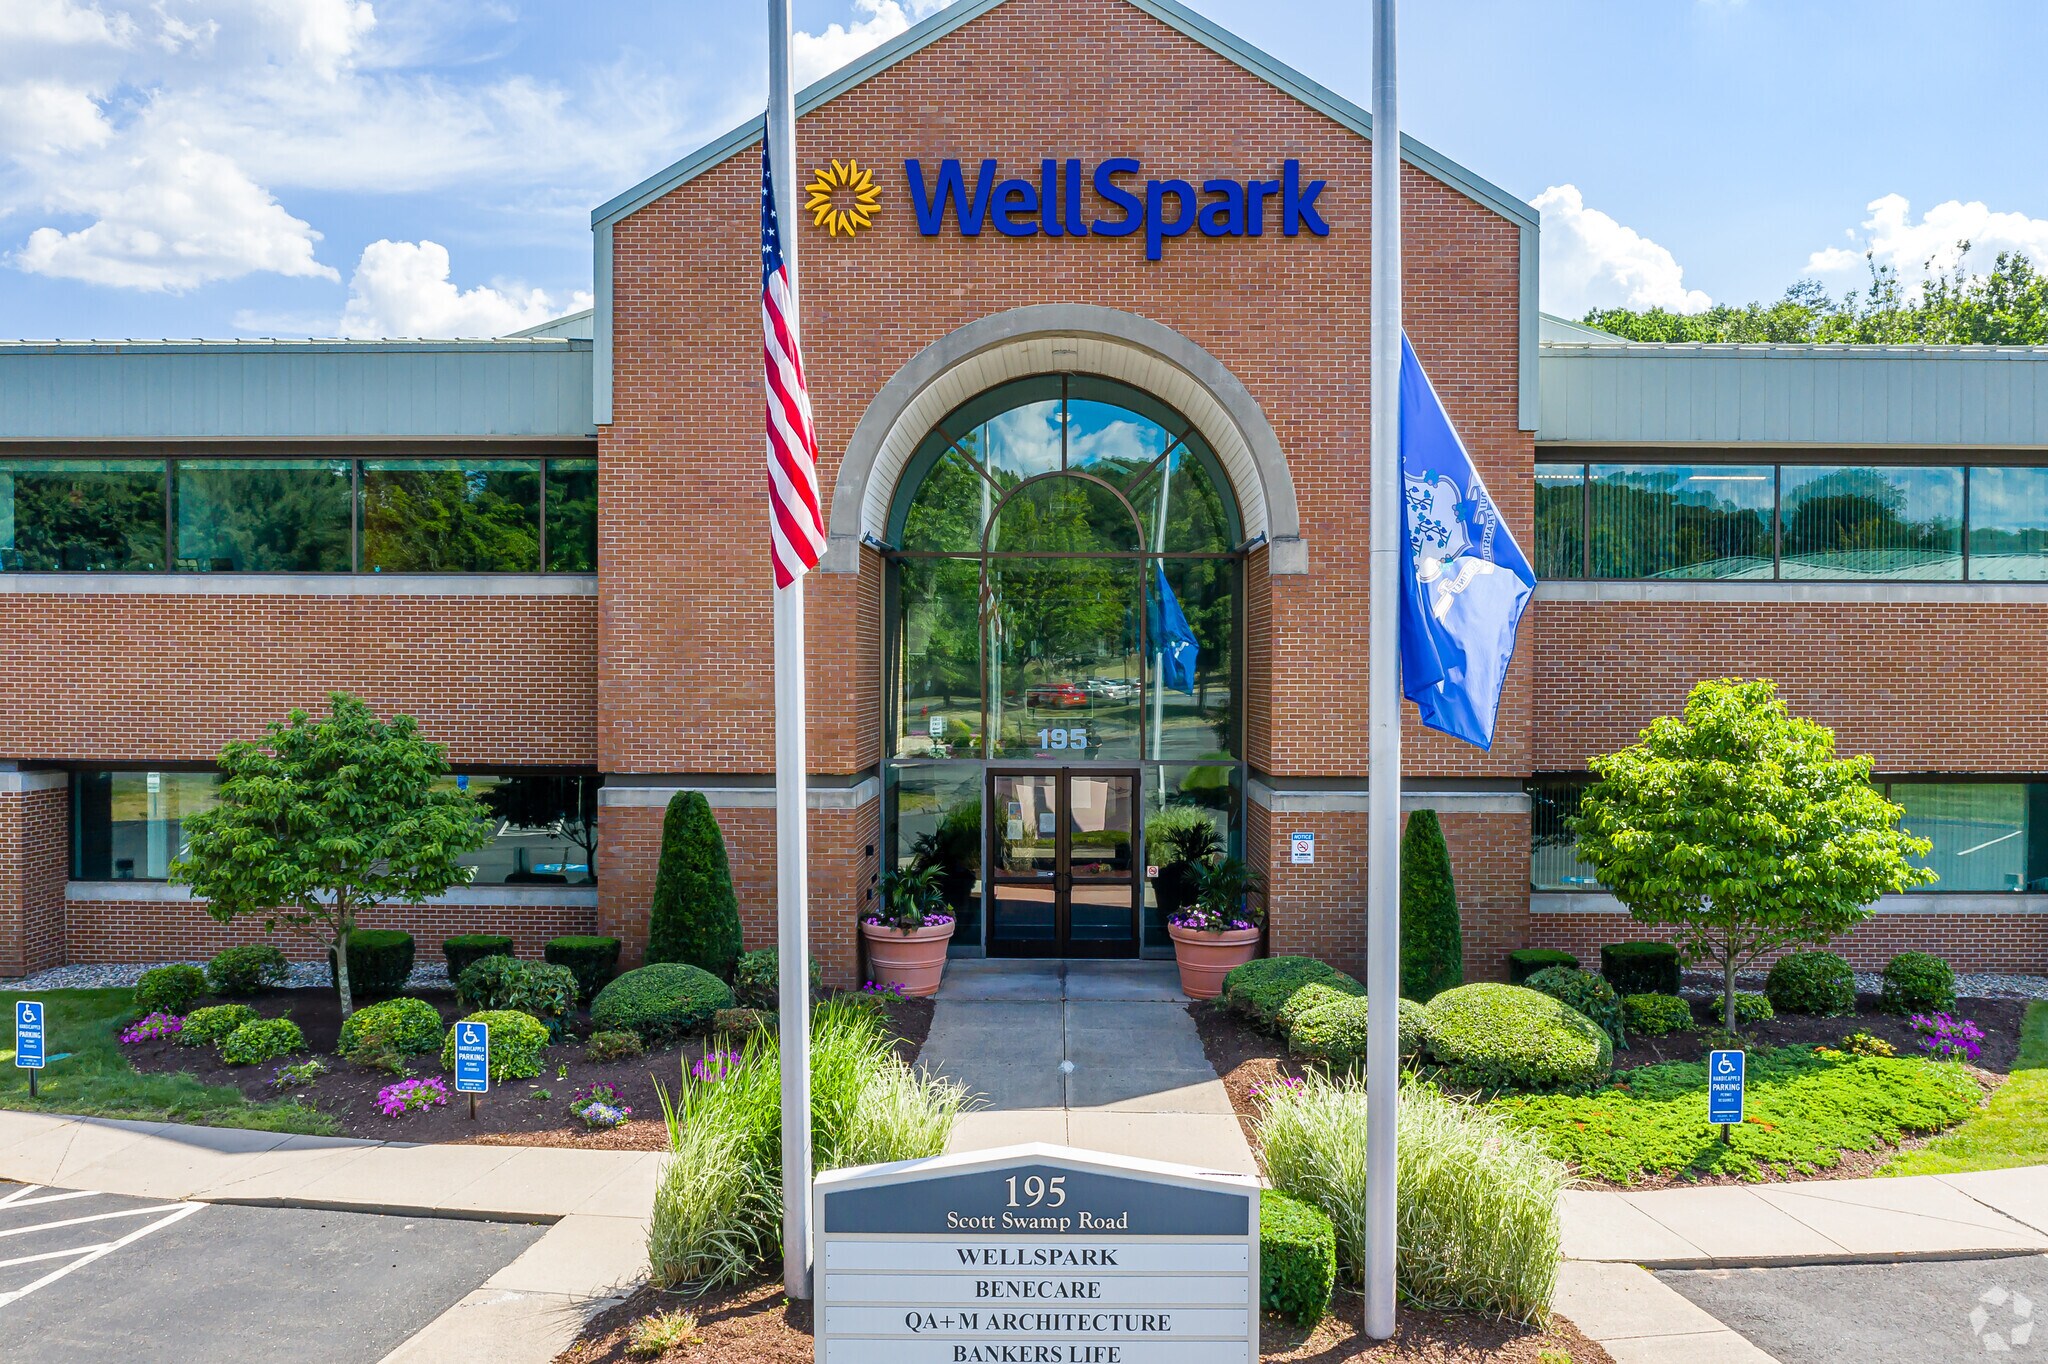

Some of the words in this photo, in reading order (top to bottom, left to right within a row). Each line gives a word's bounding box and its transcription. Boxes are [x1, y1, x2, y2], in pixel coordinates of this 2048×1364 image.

[904, 158, 1330, 260] WellSpark
[1037, 728, 1088, 750] 195
[19, 1031, 41, 1039] PARKING
[459, 1053, 485, 1061] PARKING
[1005, 1175, 1067, 1208] 195
[947, 1211, 996, 1229] Scott
[1001, 1211, 1071, 1232] Swamp
[1078, 1211, 1129, 1230] Road
[956, 1248, 1119, 1266] WELLSPARK
[975, 1280, 1101, 1299] BENECARE
[904, 1311, 980, 1333] QA+M
[985, 1313, 1172, 1332] ARCHITECTURE
[953, 1345, 1062, 1364] BANKERS
[1069, 1346, 1122, 1364] LIFE
